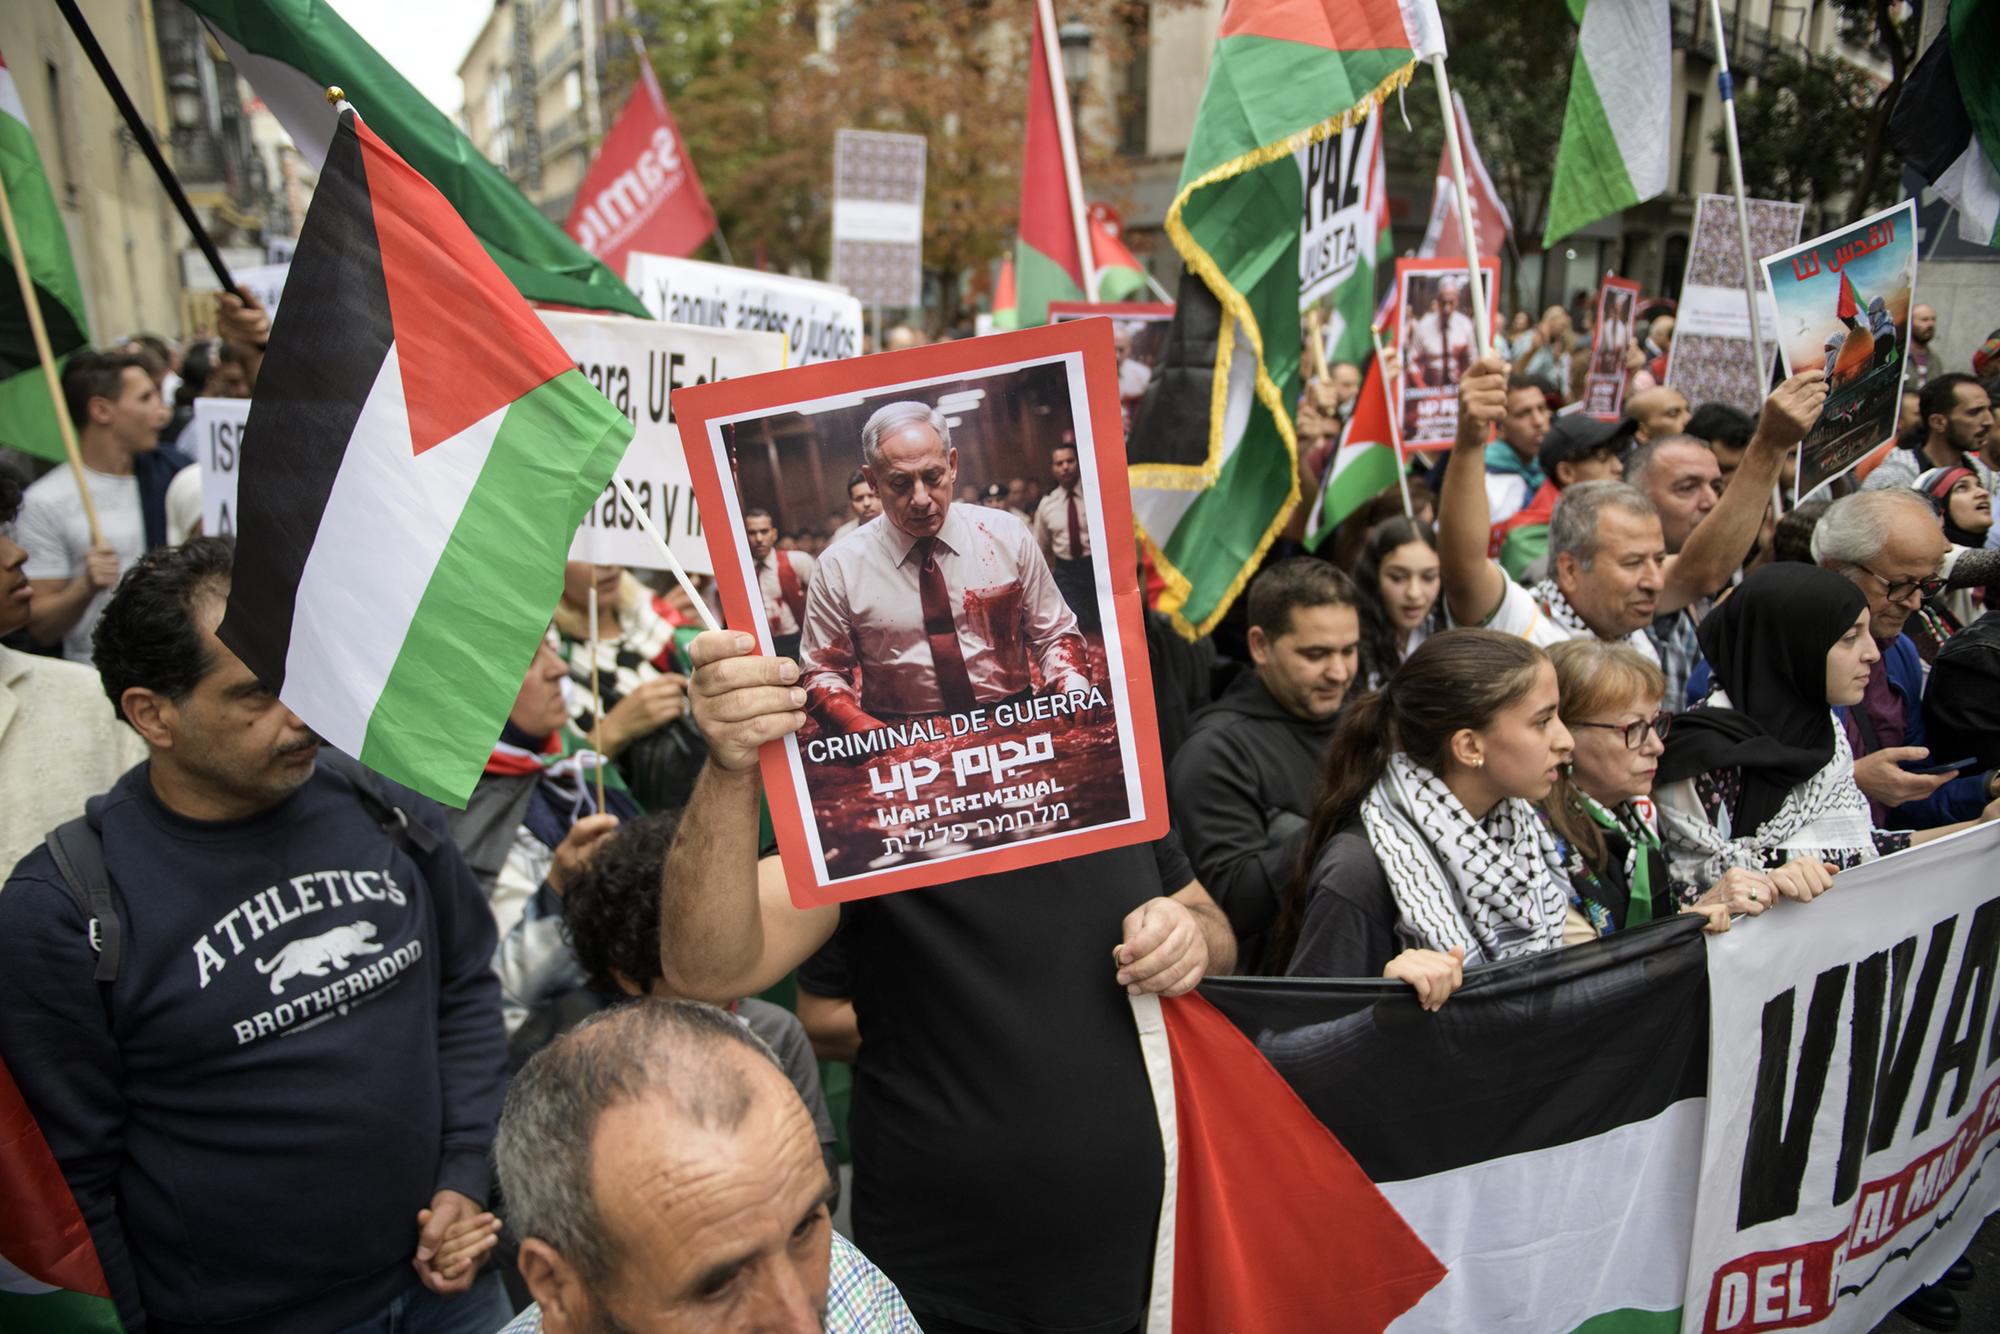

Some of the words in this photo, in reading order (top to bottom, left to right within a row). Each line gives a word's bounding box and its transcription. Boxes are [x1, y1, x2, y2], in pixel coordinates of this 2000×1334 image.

[1304, 117, 1366, 235] PAZ
[1792, 250, 1821, 282] لنا
[1827, 219, 1895, 274] القدس
[791, 318, 803, 353] o
[649, 350, 686, 424] UE
[662, 484, 679, 546] y
[807, 721, 946, 764] CRIMINAL
[951, 709, 989, 738] DE
[994, 686, 1108, 728] GUERRA
[882, 821, 969, 857] פלילית
[976, 800, 1071, 837] מלחמה
[192, 869, 408, 990] ATHLETICS
[232, 939, 424, 1046] BROTHERHOOD
[1716, 1258, 1812, 1332] DEL
[1851, 1184, 1900, 1250] AL
